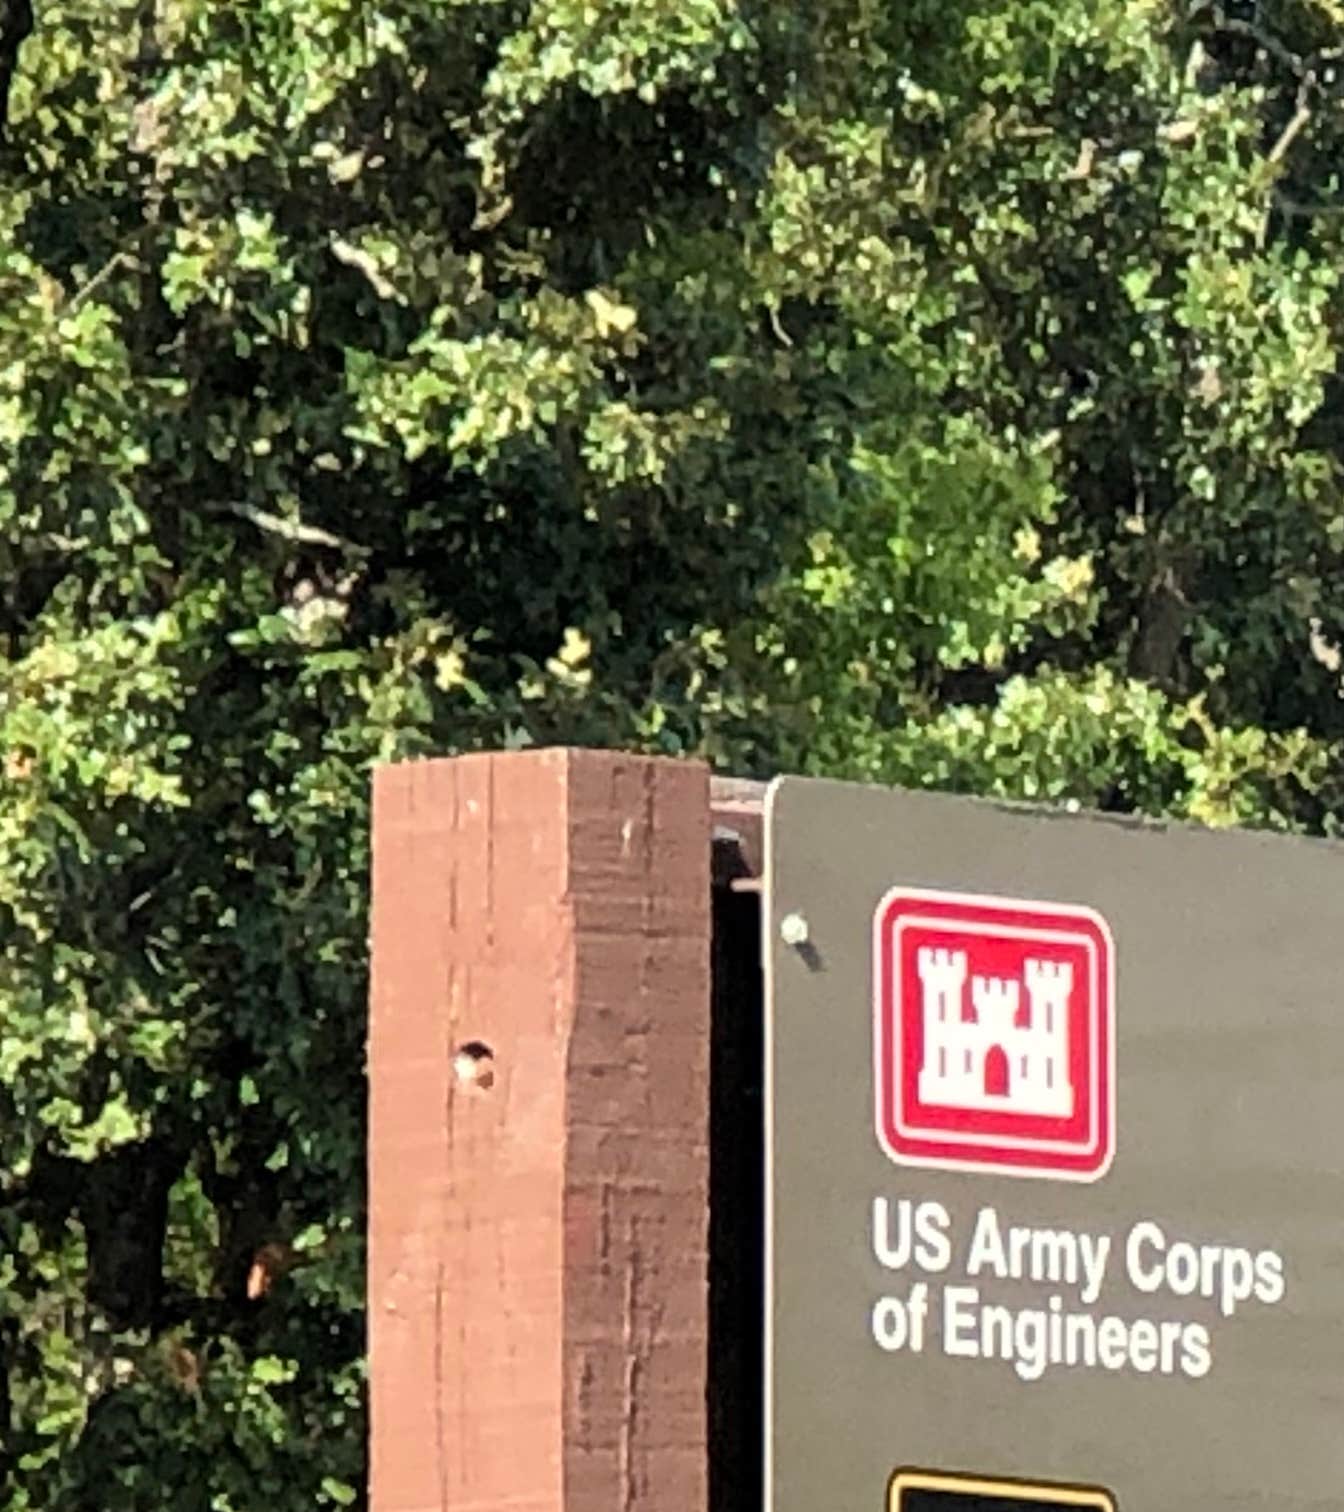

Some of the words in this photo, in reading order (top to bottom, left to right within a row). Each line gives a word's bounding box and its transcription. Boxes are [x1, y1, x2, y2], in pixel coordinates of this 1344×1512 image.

[873, 1197, 951, 1272] US
[966, 1207, 1111, 1304] Army
[1126, 1221, 1286, 1317] Corps
[873, 1282, 929, 1353] of
[943, 1285, 1212, 1381] Engineers
